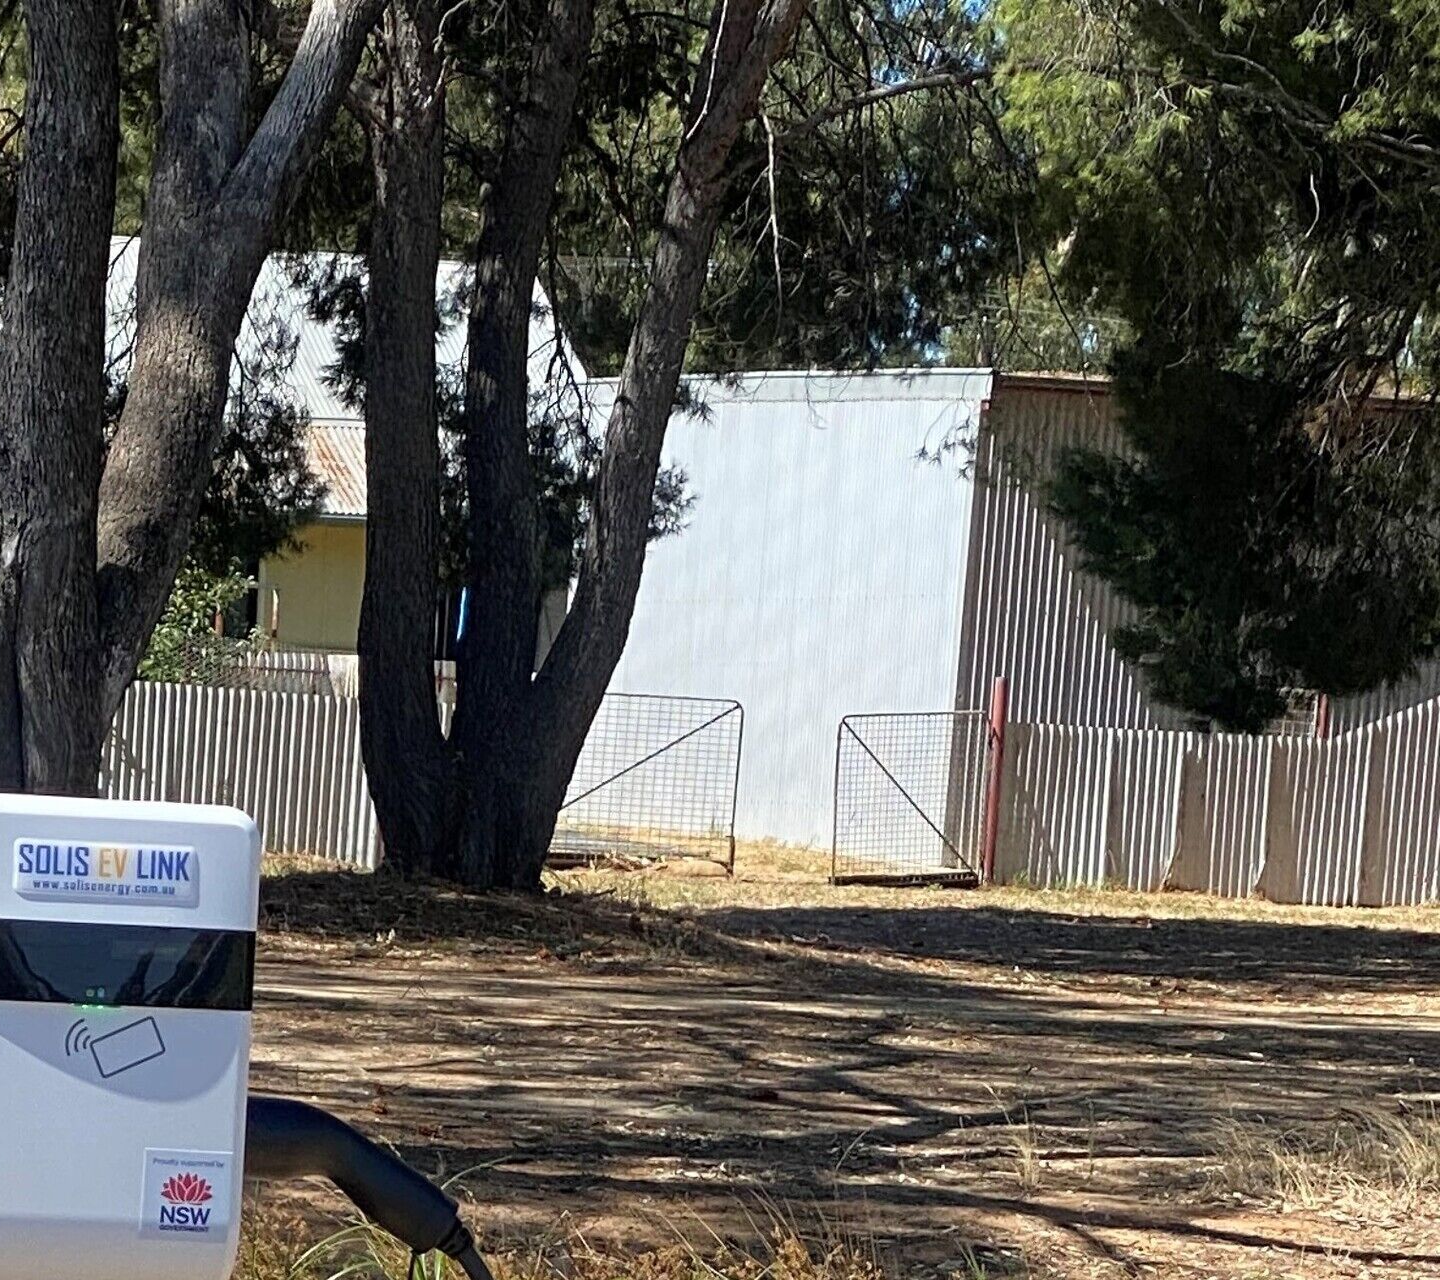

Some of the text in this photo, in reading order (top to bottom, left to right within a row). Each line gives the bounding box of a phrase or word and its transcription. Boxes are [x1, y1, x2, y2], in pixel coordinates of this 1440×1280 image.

[19, 844, 190, 881] SOLIS EV LINK
[33, 879, 175, 895] www.solisenergy.com.au
[160, 1205, 211, 1225] NSW
